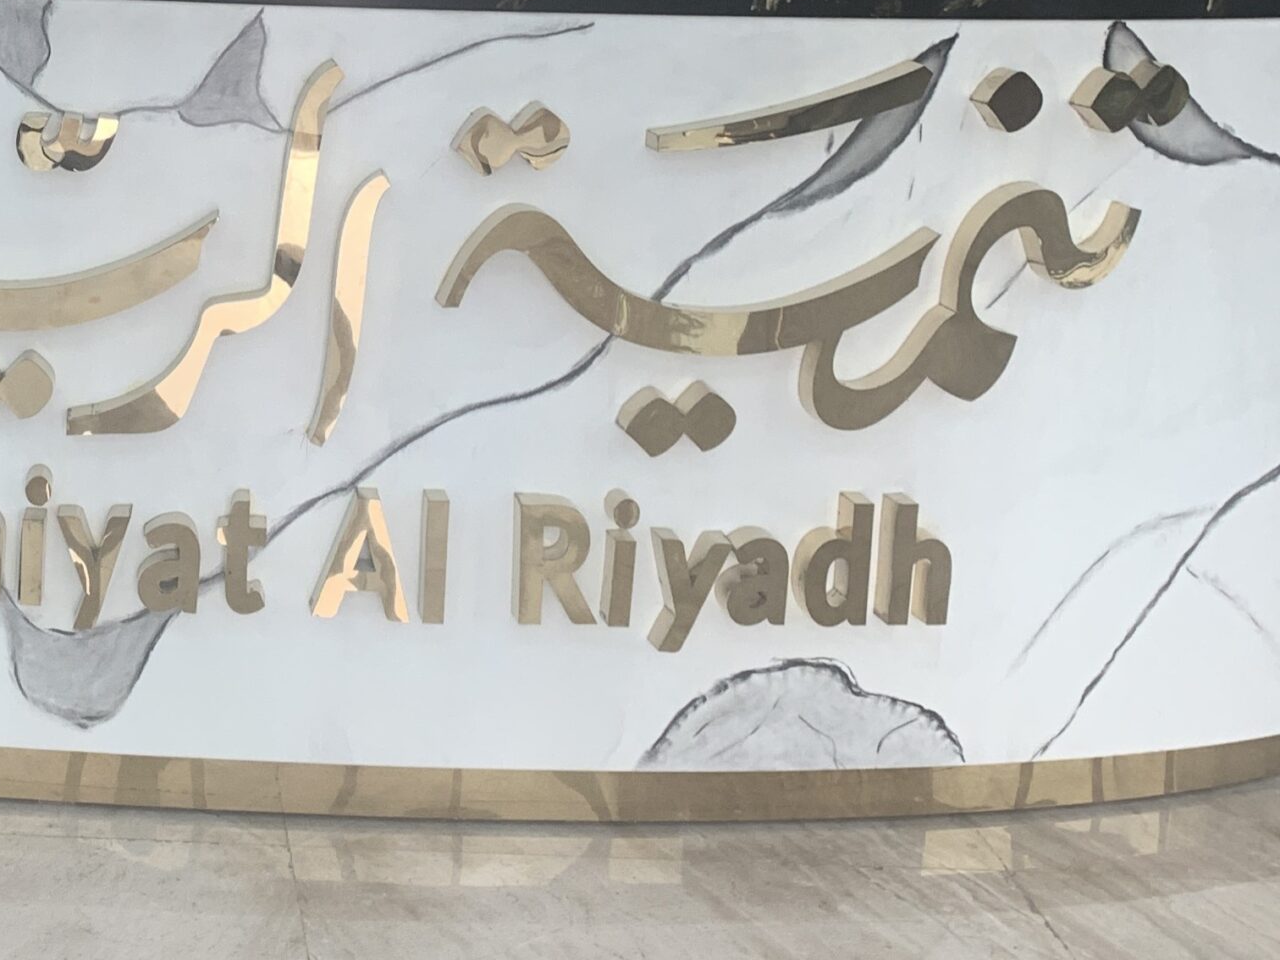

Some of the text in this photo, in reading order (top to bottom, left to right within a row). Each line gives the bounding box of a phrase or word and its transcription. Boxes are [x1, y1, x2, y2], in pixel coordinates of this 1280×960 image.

[434, 58, 1192, 458] تنمية
[309, 487, 450, 625] Al
[511, 490, 954, 654] Riyadh
